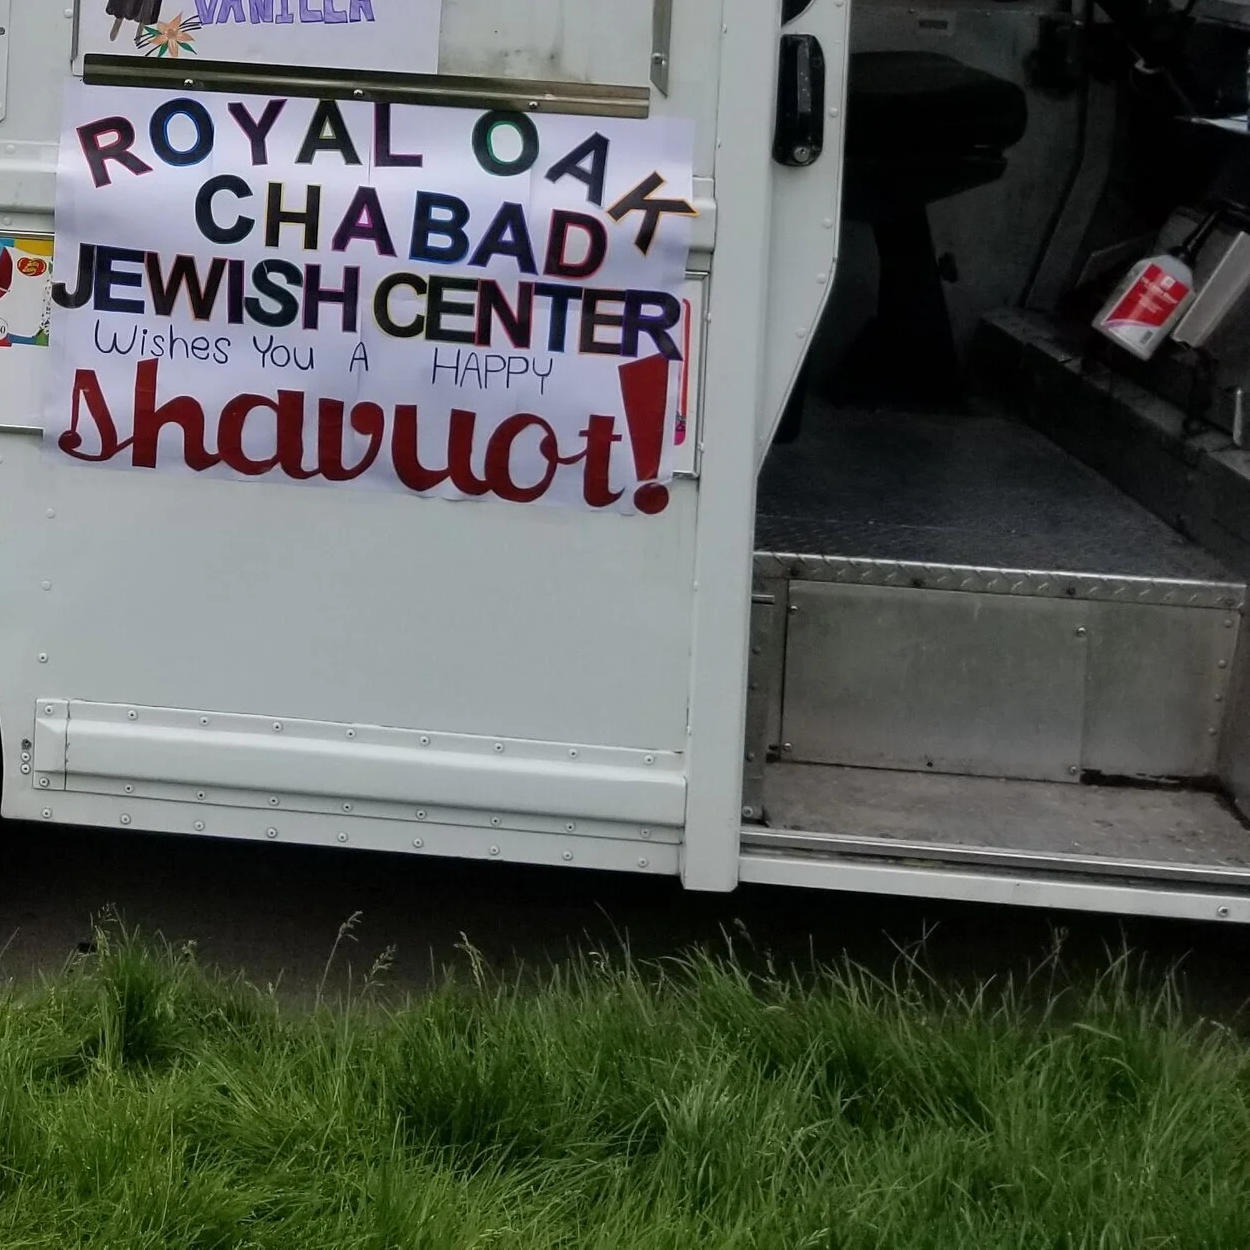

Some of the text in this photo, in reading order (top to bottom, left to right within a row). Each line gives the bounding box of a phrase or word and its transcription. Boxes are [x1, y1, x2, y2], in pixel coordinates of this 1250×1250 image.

[75, 97, 698, 255] ROYAL OAK
[194, 174, 608, 280] CHABAD
[51, 243, 682, 362] JEWISH CENTER
[95, 319, 553, 395] Wishes You A HAPPY
